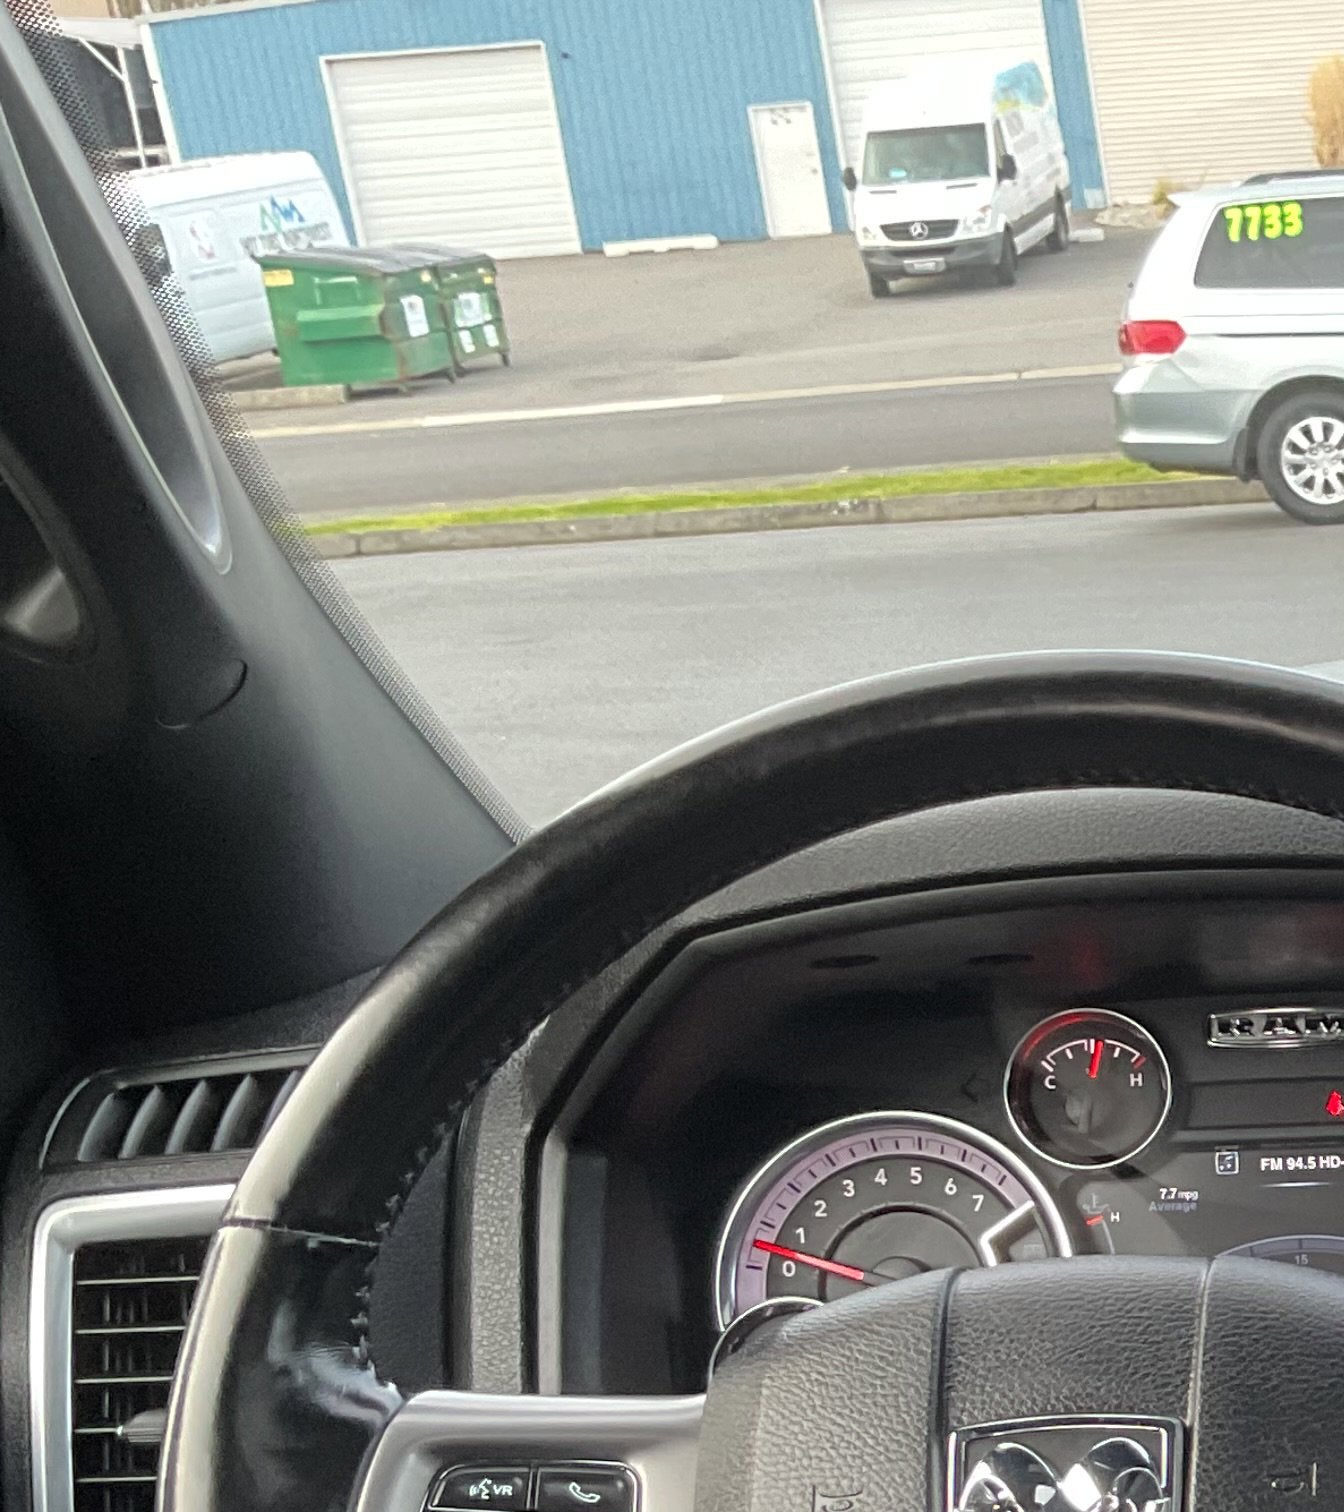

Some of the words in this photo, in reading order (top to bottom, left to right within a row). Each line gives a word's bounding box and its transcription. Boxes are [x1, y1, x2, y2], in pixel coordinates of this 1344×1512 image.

[1223, 201, 1304, 242] 7733
[1044, 1075, 1056, 1089] C
[1130, 1073, 1143, 1087] H
[1260, 1157, 1283, 1171] FM
[1286, 1156, 1317, 1170] 94.5
[874, 1168, 888, 1186] 4
[910, 1167, 923, 1184] 5
[842, 1180, 855, 1197] 3
[944, 1178, 957, 1195] 6
[814, 1200, 827, 1218] 2
[972, 1194, 984, 1212] 7
[1110, 1212, 1120, 1223] H
[796, 1227, 806, 1244] 1
[1294, 1254, 1309, 1265] 15
[782, 1260, 796, 1278] 0
[493, 1484, 513, 1496] VR
